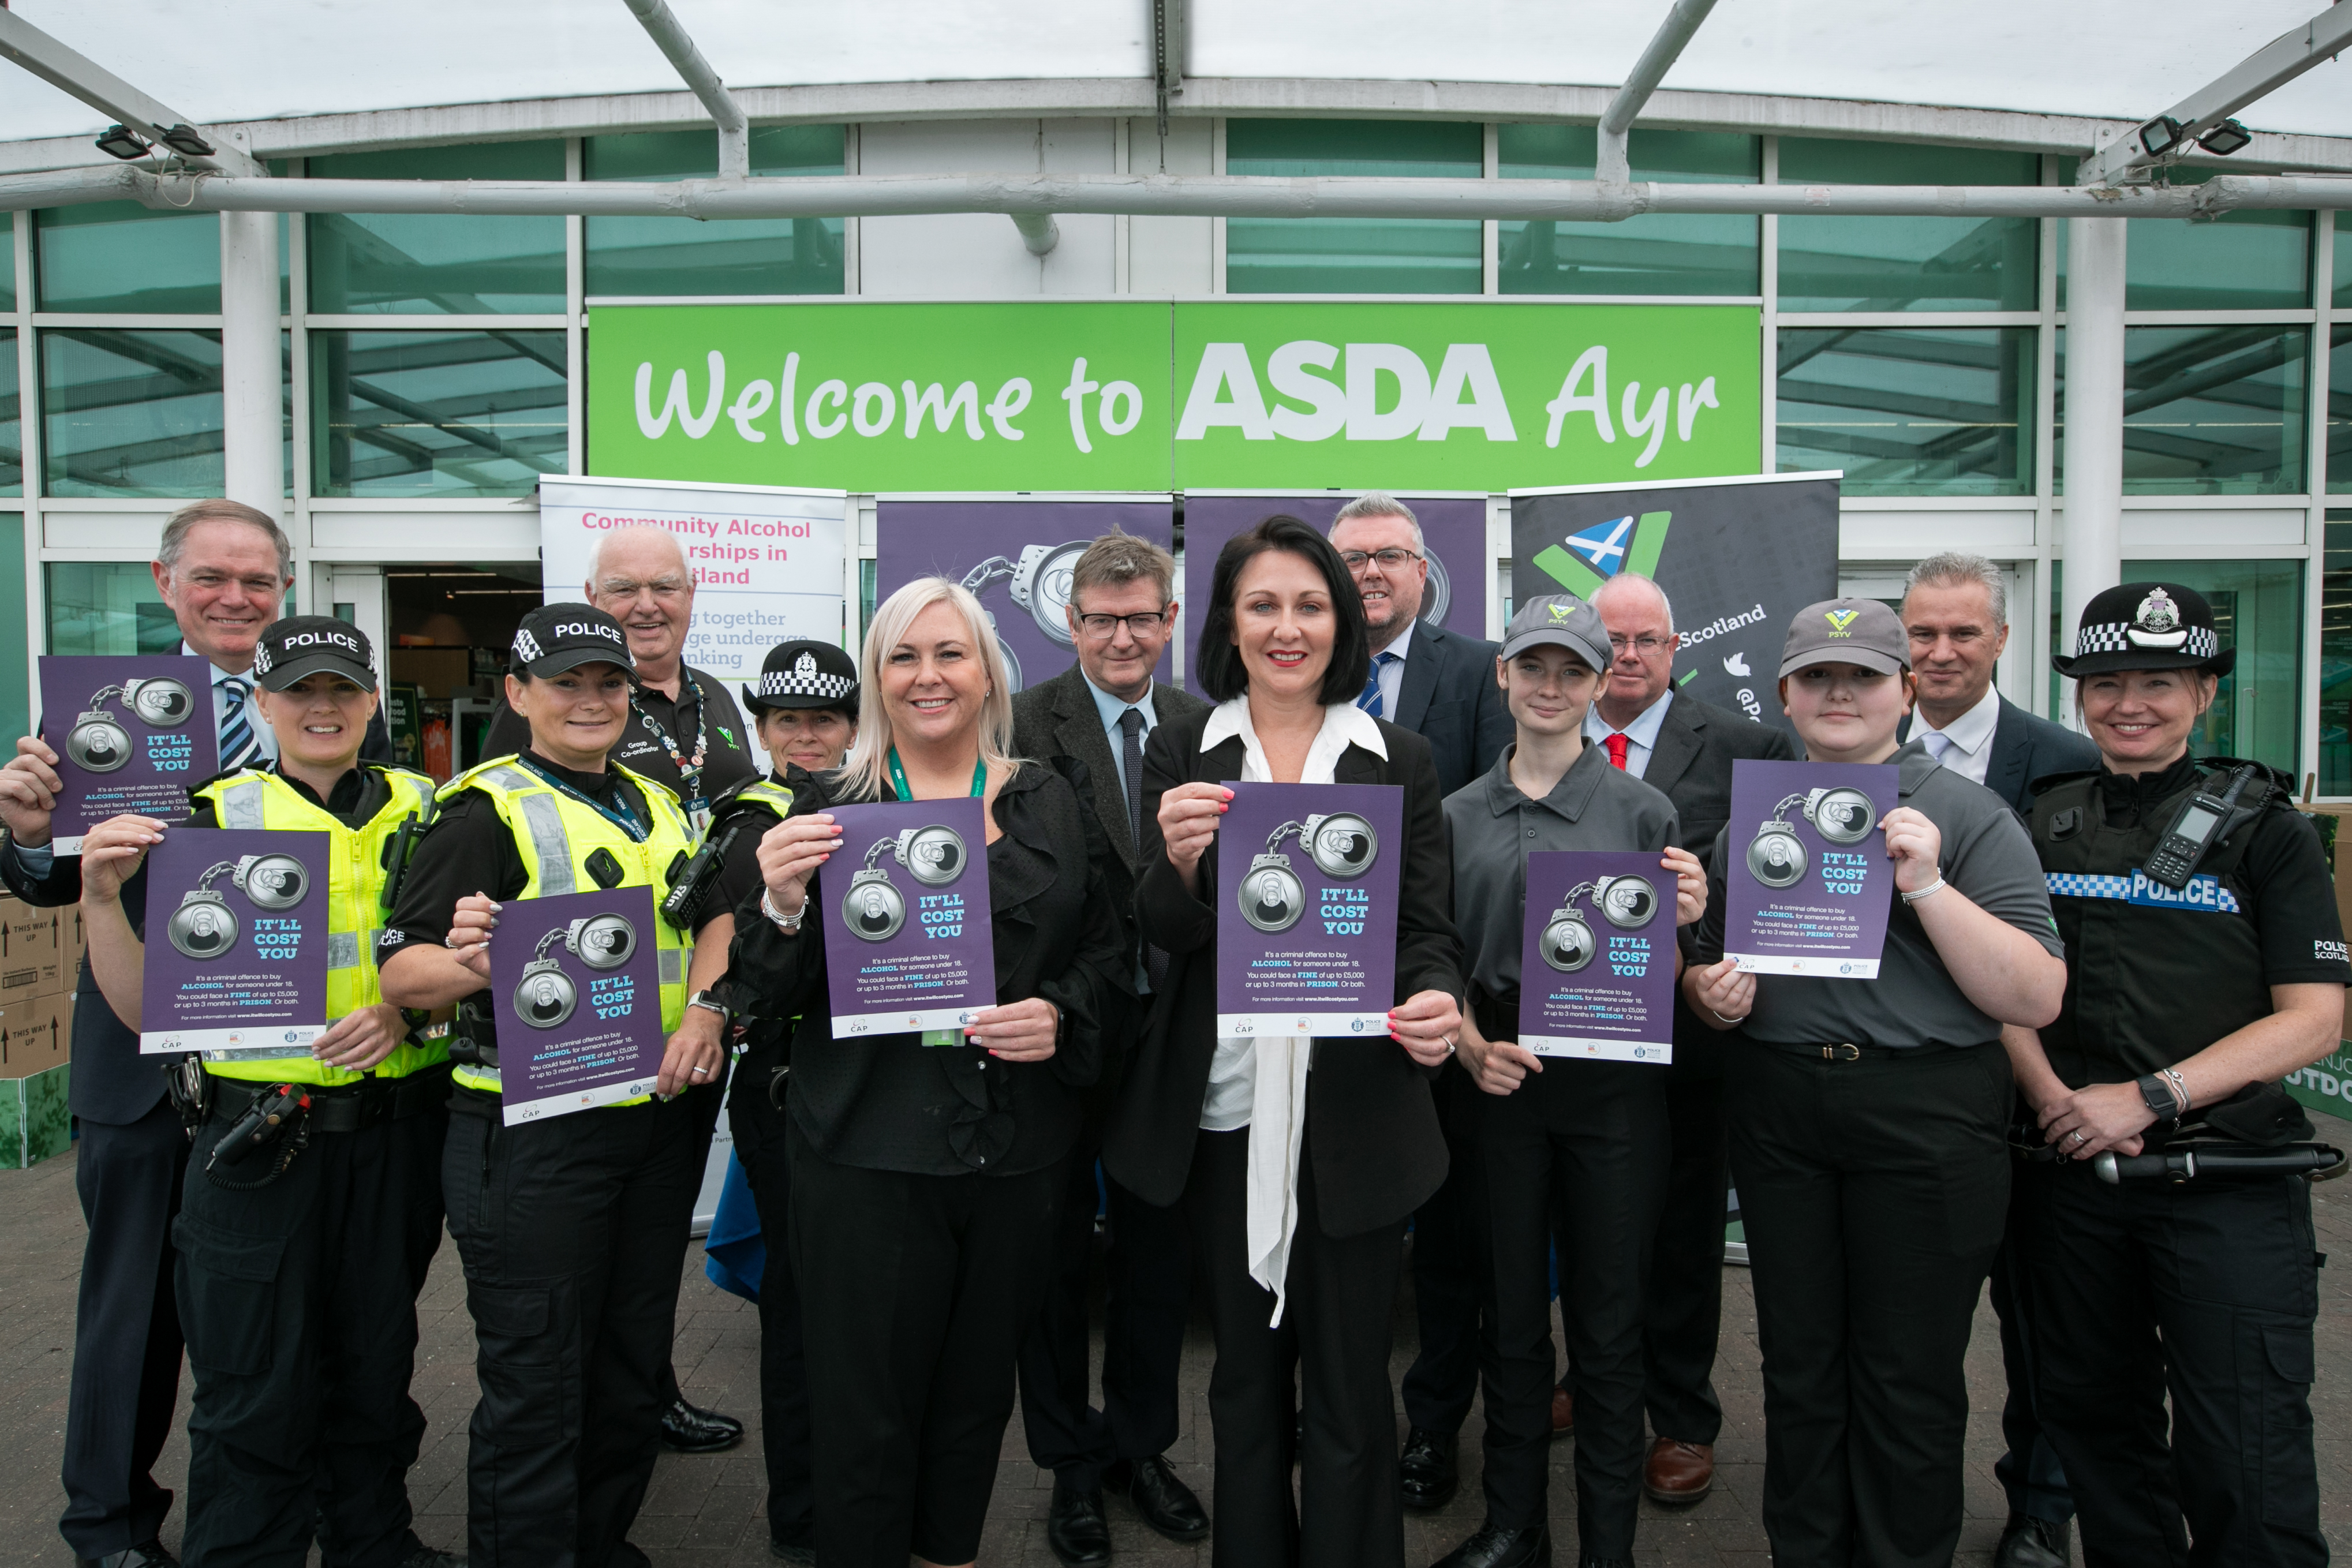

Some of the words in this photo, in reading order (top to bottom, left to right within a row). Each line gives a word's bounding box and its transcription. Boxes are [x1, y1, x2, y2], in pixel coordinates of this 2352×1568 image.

[635, 350, 1032, 446] Welcome
[1061, 357, 1143, 453] to
[1175, 340, 1518, 441] ASDA
[1545, 346, 1719, 467] Ayr
[582, 512, 719, 538] Community
[727, 519, 810, 538] Alcohol
[690, 542, 760, 563] rships
[768, 545, 787, 561] in
[692, 567, 750, 584] tland
[702, 609, 786, 629] together
[555, 623, 622, 645] POLICE
[285, 632, 358, 653] POLICE
[147, 735, 190, 746] IT'LL
[628, 740, 648, 749] Group
[148, 747, 192, 758] COST
[620, 746, 659, 758] Co-ordinator
[152, 760, 189, 771] YOU
[1823, 853, 1867, 866] IT'LL
[1822, 867, 1867, 880] COST
[1321, 889, 1368, 901] IT'LL
[1825, 882, 1862, 895] YOU
[2133, 874, 2216, 905] POLICE
[920, 894, 964, 908] IT'LL
[921, 909, 964, 923] COST
[1321, 905, 1368, 918] COST
[14, 924, 31, 933] THIS
[33, 922, 48, 931] WAY
[255, 919, 301, 930] IT'LL
[1324, 922, 1364, 934] YOU
[27, 934, 36, 942] UP
[925, 925, 962, 938] YOU
[254, 934, 301, 945] COST
[1610, 937, 1650, 949] IT'LL
[257, 948, 297, 959] YOU
[2314, 940, 2349, 955] POLICE
[1609, 951, 1650, 963] COST
[1611, 965, 1646, 976] YOU
[591, 975, 633, 991] IT'LL
[592, 989, 634, 1005] COST
[596, 1004, 632, 1019] YOU
[13, 1030, 29, 1039] THIS
[31, 1024, 47, 1034] WAY
[25, 1038, 35, 1046] UP
[533, 1049, 571, 1061] ALCOHOL
[582, 1043, 607, 1051] someone
[522, 1110, 540, 1118] CAP
